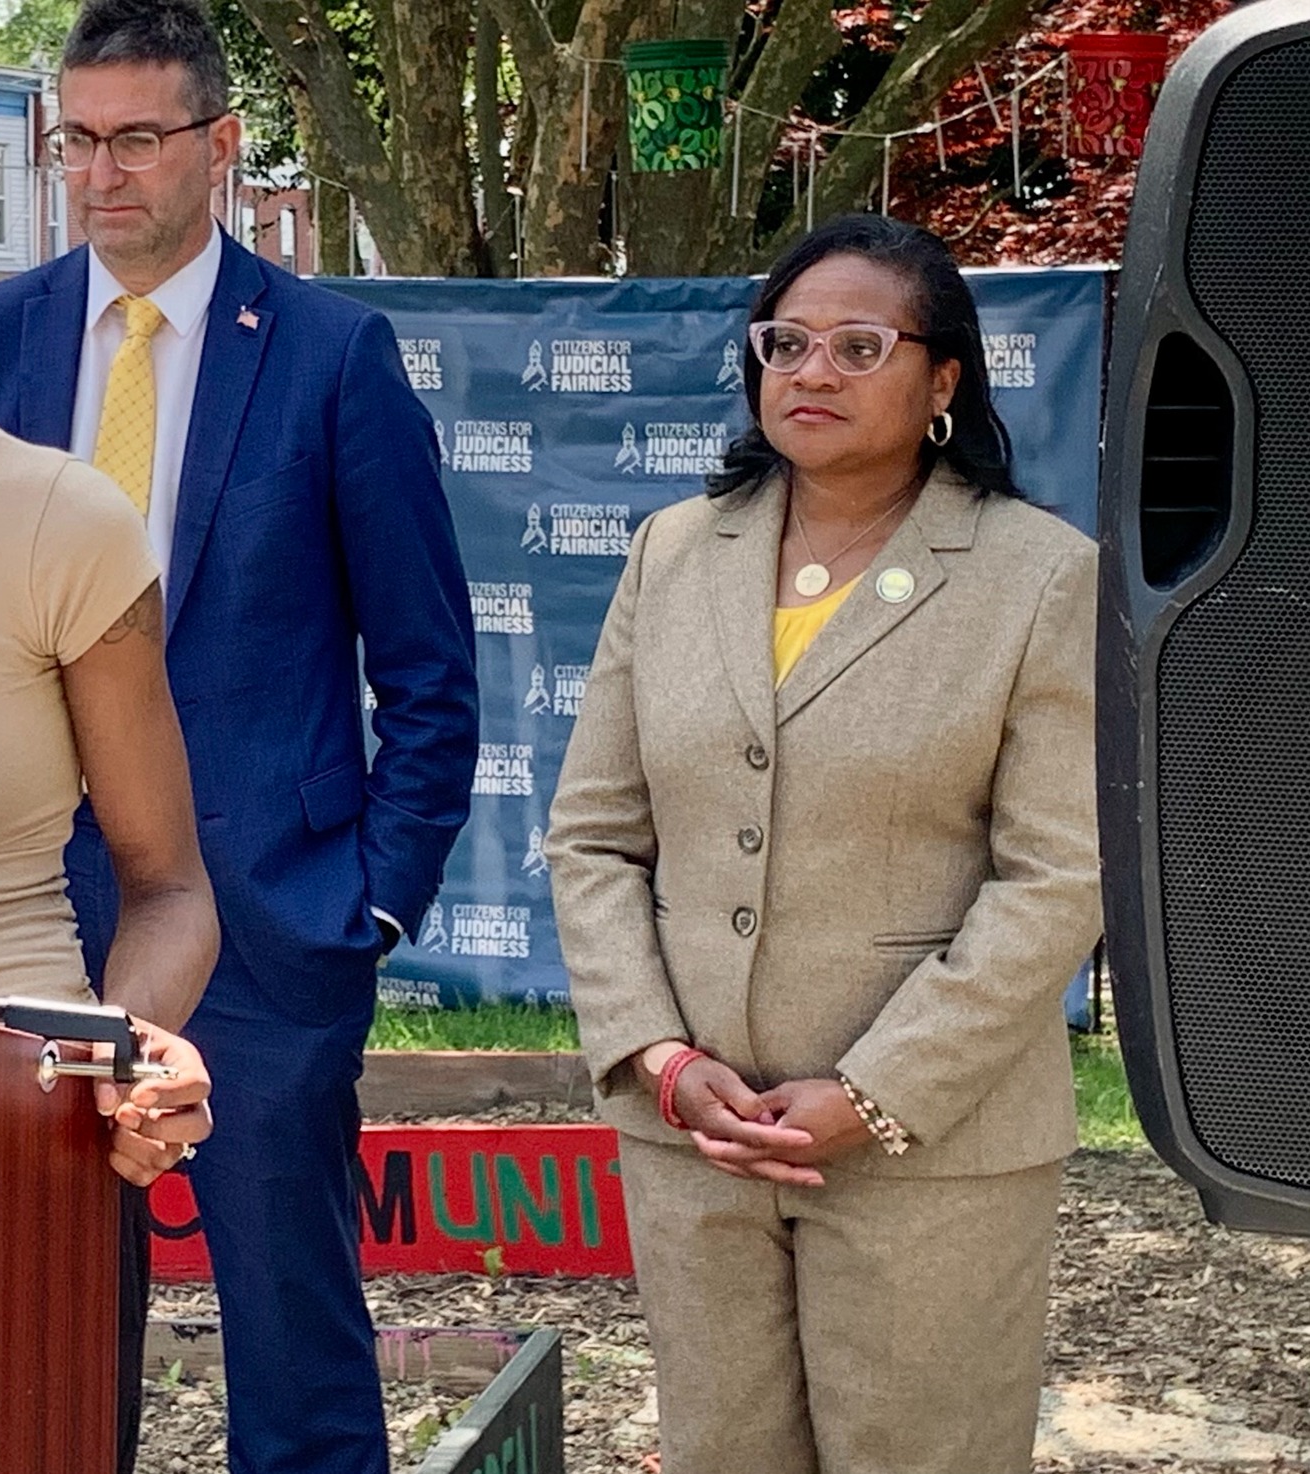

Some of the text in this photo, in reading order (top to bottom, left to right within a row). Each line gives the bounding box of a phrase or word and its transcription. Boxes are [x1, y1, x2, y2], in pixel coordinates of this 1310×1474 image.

[418, 338, 441, 353] FOR
[551, 340, 632, 355] CITIZENS FOR
[1010, 334, 1036, 349] FOR
[402, 353, 442, 372] CIAL
[551, 355, 632, 374] JUDICIAL
[984, 349, 1036, 369] ICIAL
[551, 374, 632, 392] FAIRNESS
[990, 369, 1035, 388] NESS
[454, 420, 533, 436] CITIZENS FOR
[645, 422, 727, 438] CITIZENS FOR
[453, 435, 533, 455] JUDICIAL
[452, 454, 532, 473] FAIRNESS
[645, 456, 725, 475] FAIRNESS
[551, 504, 630, 519] CITIZENS FOR
[551, 518, 631, 538] JUDICIAL
[551, 537, 631, 556] FAIRNESS
[467, 582, 533, 598] TIZENS FOR
[475, 615, 534, 634] IRNESS
[509, 744, 533, 759] FOR
[475, 757, 534, 778] DICIAL
[471, 777, 533, 796] IRNESS
[451, 903, 531, 922] CITIZENS FOR
[451, 919, 531, 941] JUDICIAL
[451, 938, 530, 959] FAIRNESS
